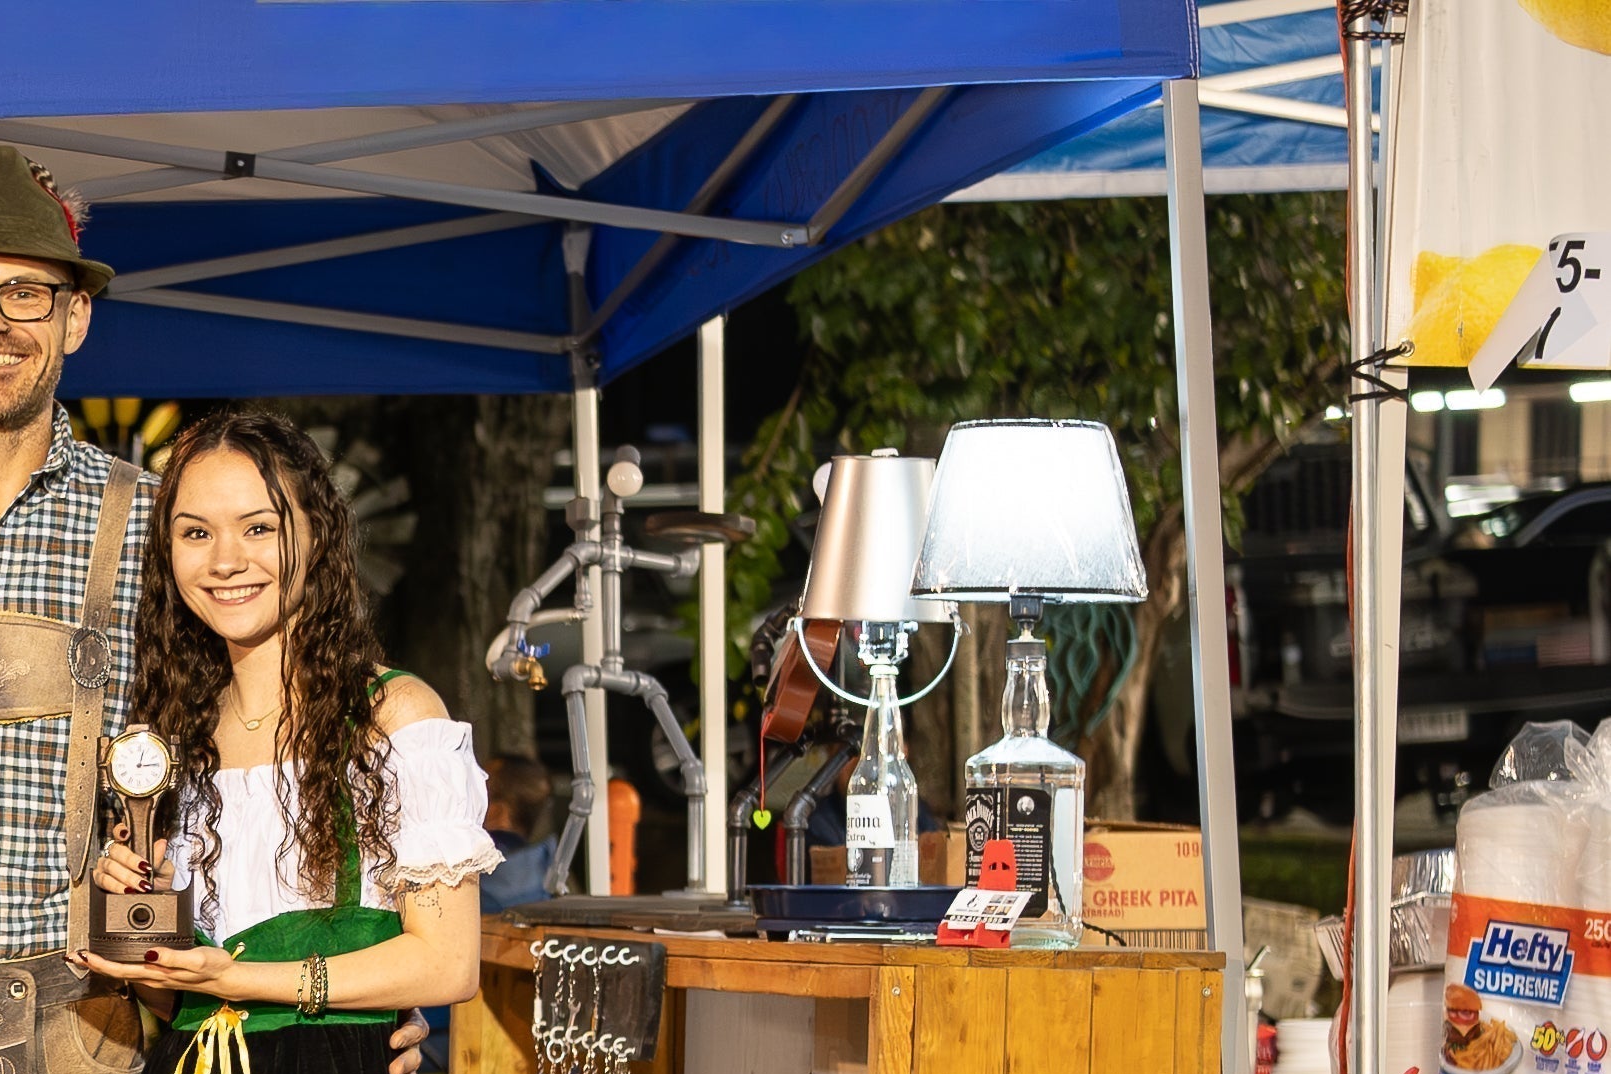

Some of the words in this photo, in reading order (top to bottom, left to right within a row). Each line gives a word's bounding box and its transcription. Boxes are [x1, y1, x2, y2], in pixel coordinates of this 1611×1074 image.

[1175, 841, 1203, 858] 109
[1092, 889, 1152, 908] GREEK
[1159, 889, 1198, 908] PITA
[1486, 926, 1563, 972] Hefty
[1473, 968, 1560, 1001] SUPREME
